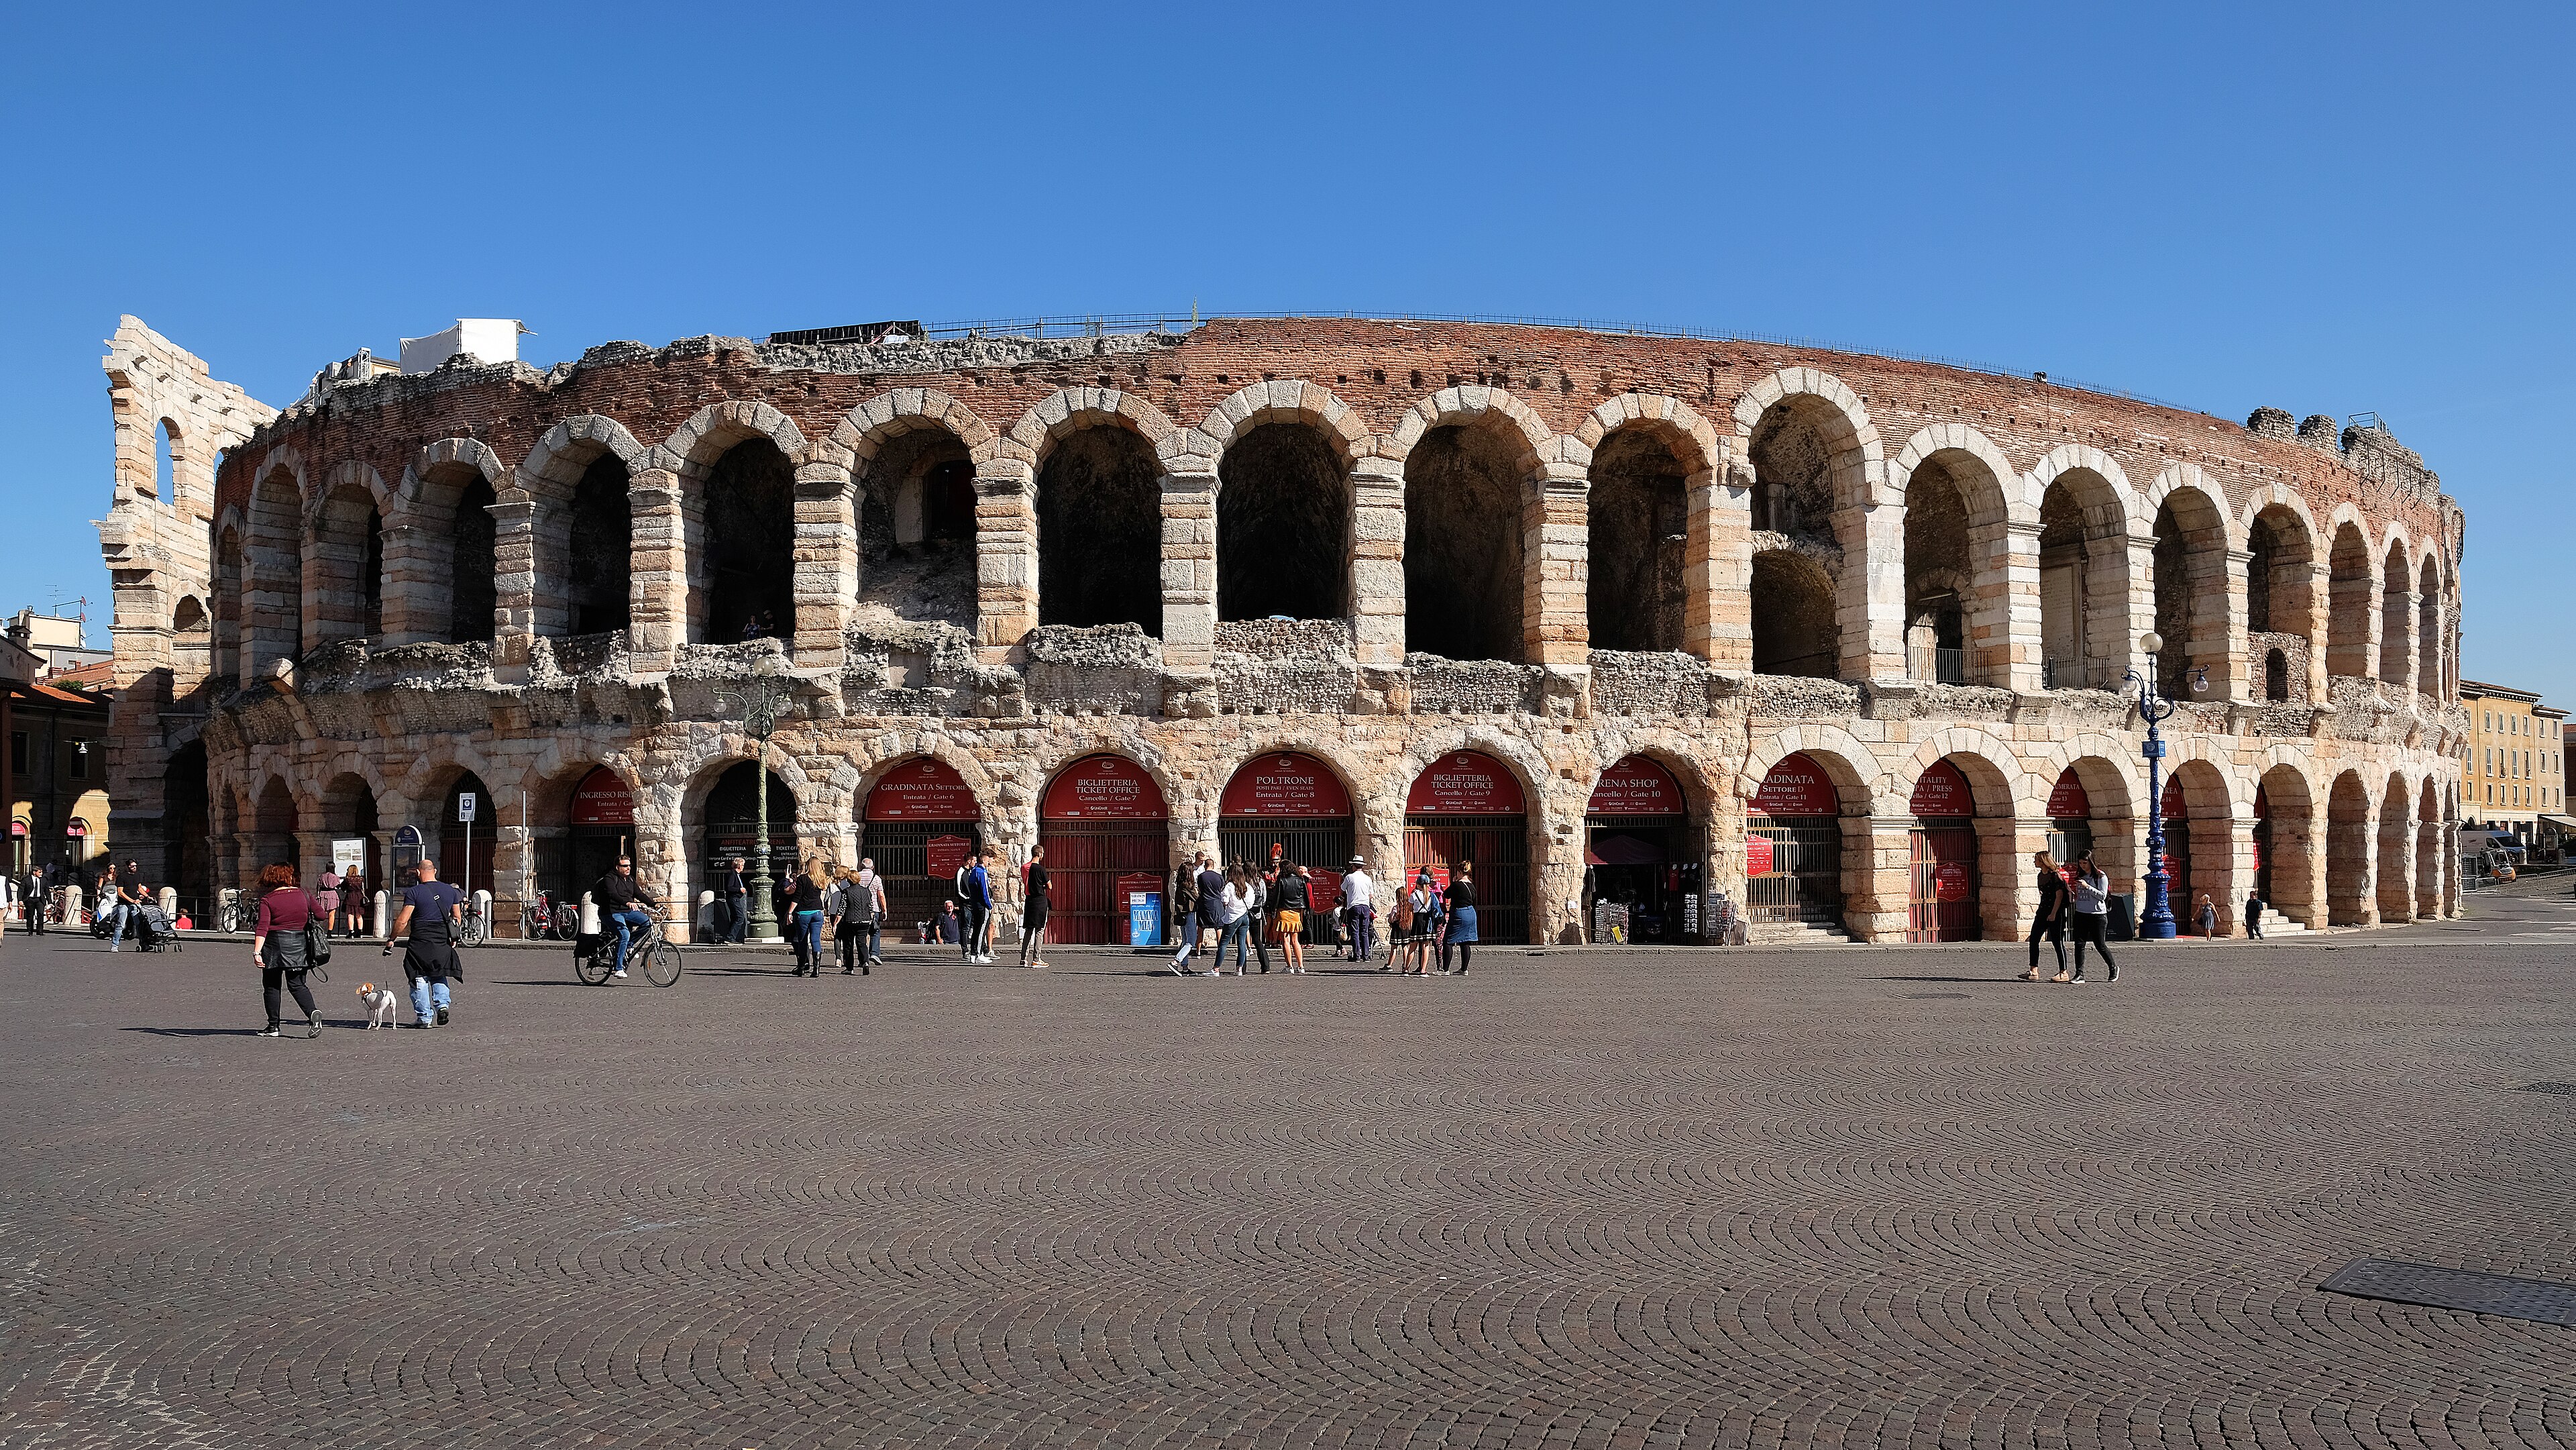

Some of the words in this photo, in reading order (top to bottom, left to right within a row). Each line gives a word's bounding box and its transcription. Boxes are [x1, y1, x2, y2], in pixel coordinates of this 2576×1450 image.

[1256, 776, 1314, 784] POLTRONE
[1630, 779, 1658, 787] SHOP
[1133, 910, 1159, 921] MAMMA
